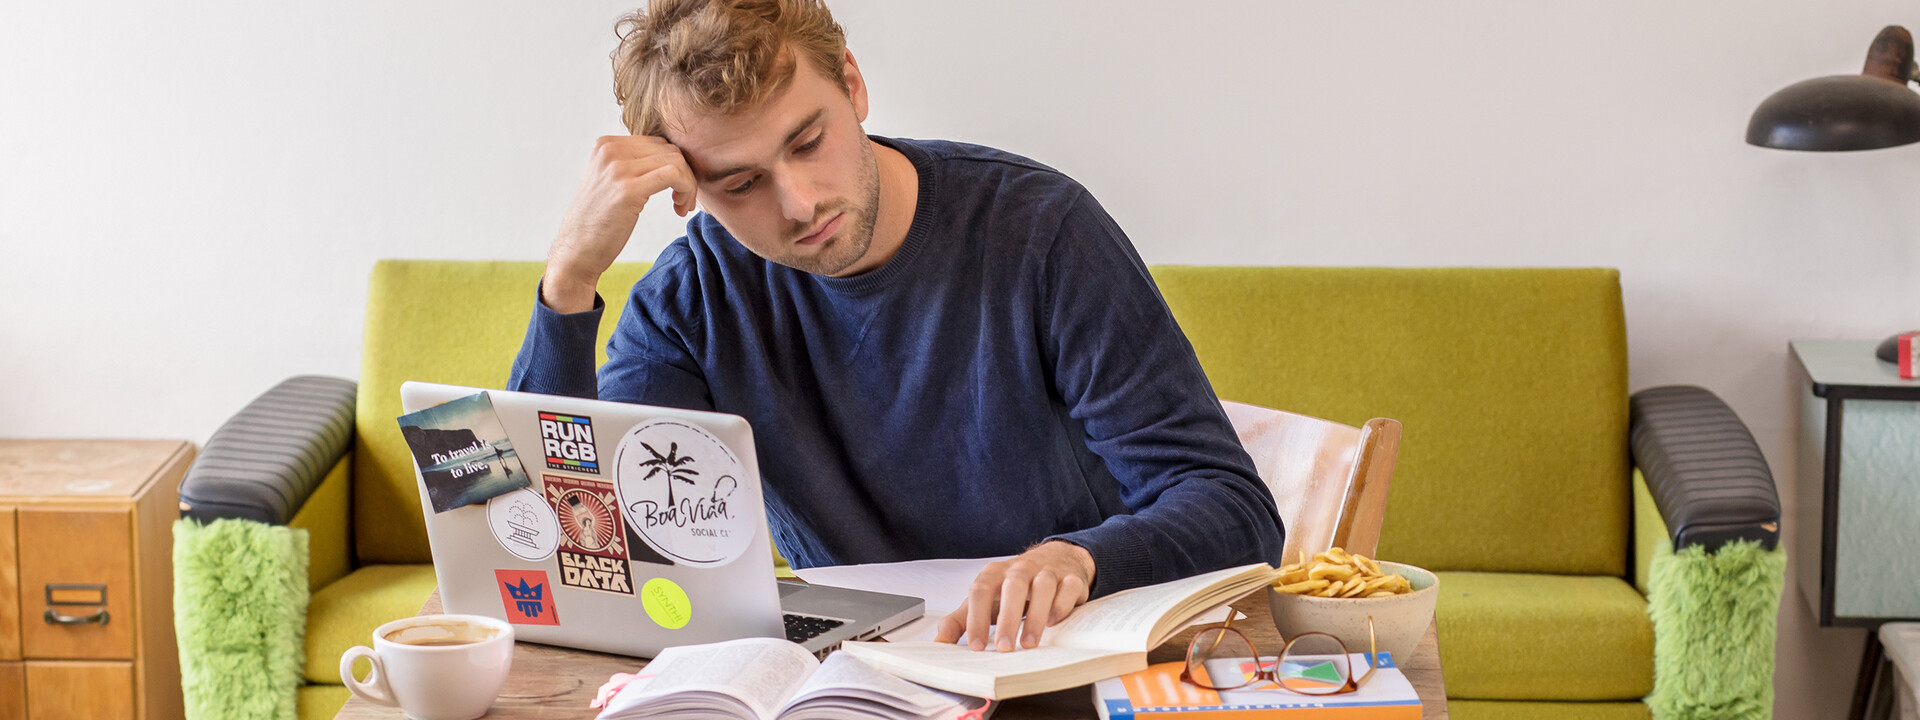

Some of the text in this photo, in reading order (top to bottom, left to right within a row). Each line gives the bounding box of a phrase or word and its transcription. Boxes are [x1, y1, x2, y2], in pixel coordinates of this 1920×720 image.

[541, 420, 593, 443] RUN
[431, 439, 492, 465] To travel is
[544, 439, 596, 462] RGB
[450, 461, 488, 479] to live.
[691, 528, 718, 537] SOCIAL
[561, 552, 625, 574] BLACK
[564, 566, 631, 593] DATA
